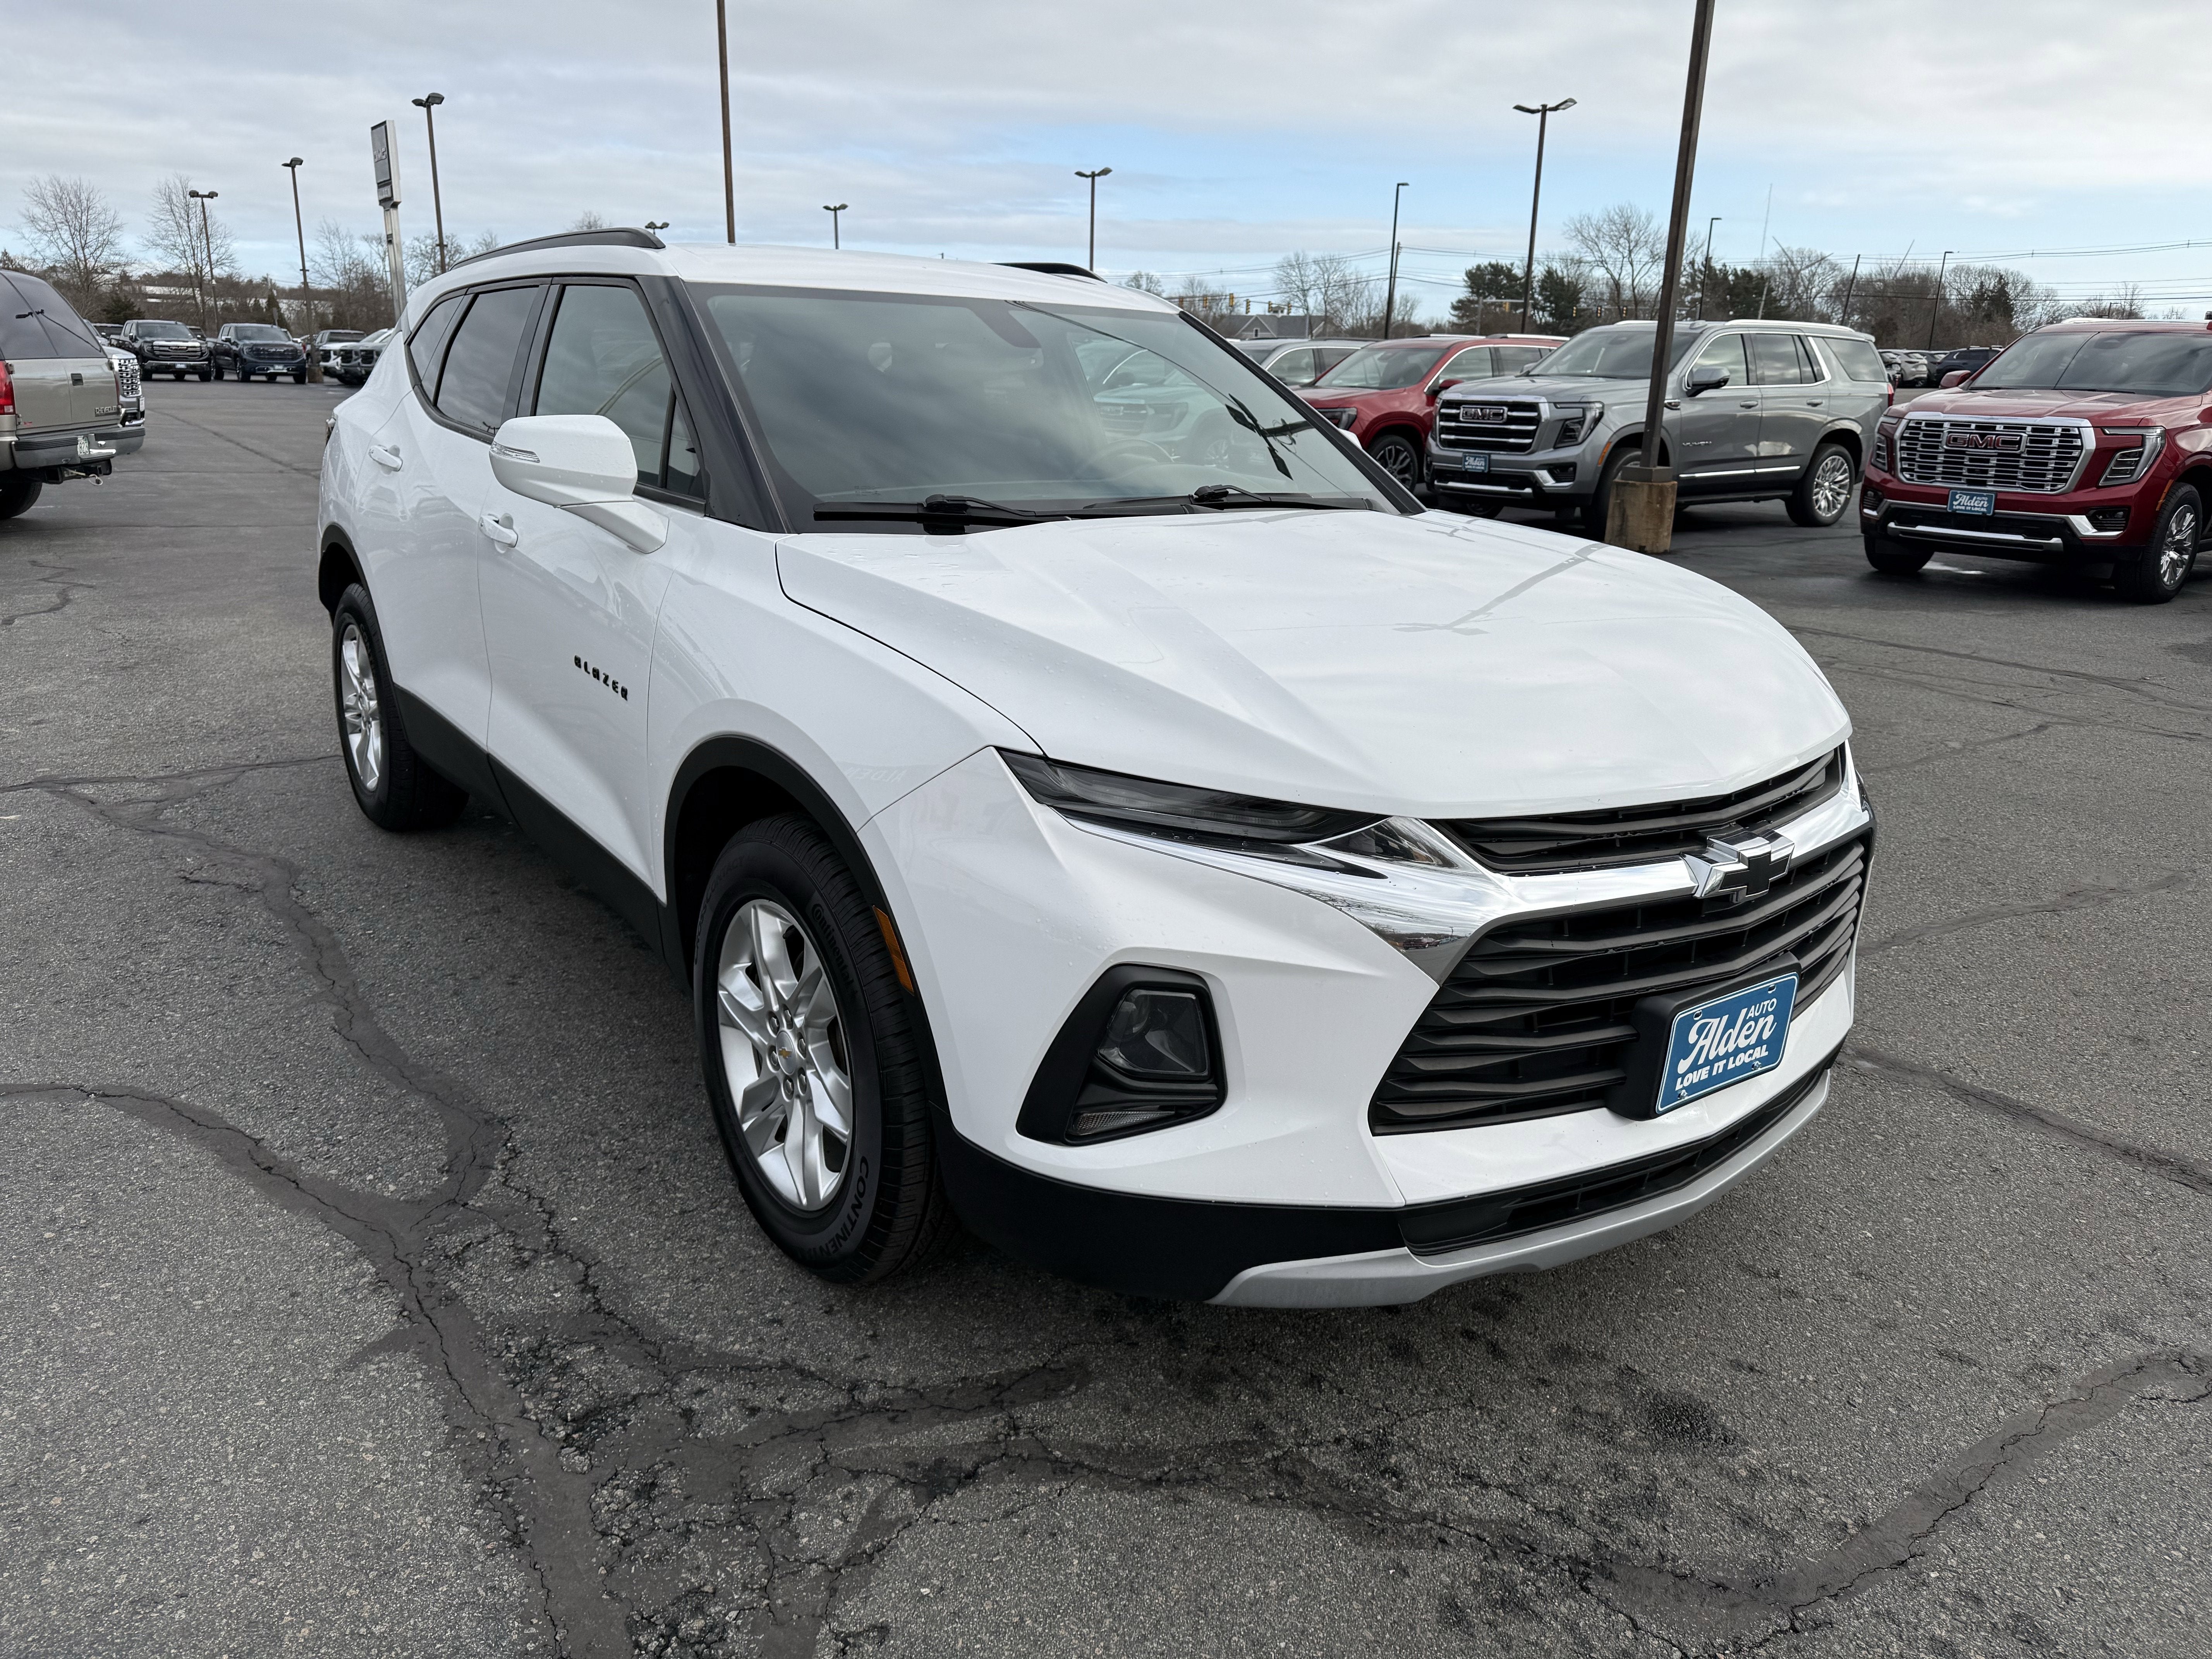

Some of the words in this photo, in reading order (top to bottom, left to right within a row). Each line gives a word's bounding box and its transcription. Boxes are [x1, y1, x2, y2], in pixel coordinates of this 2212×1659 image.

[1463, 408, 1503, 420] GMC
[1947, 433, 2020, 450] GMC
[1953, 494, 1989, 507] Alden
[574, 655, 628, 701] BLAZER
[812, 903, 854, 986] Continental
[1746, 998, 1777, 1020] AUTO
[1678, 1008, 1777, 1074] Alden
[1675, 1066, 1709, 1091] LOVE
[1712, 1060, 1726, 1076] IT
[1728, 1045, 1769, 1069] LOCAL
